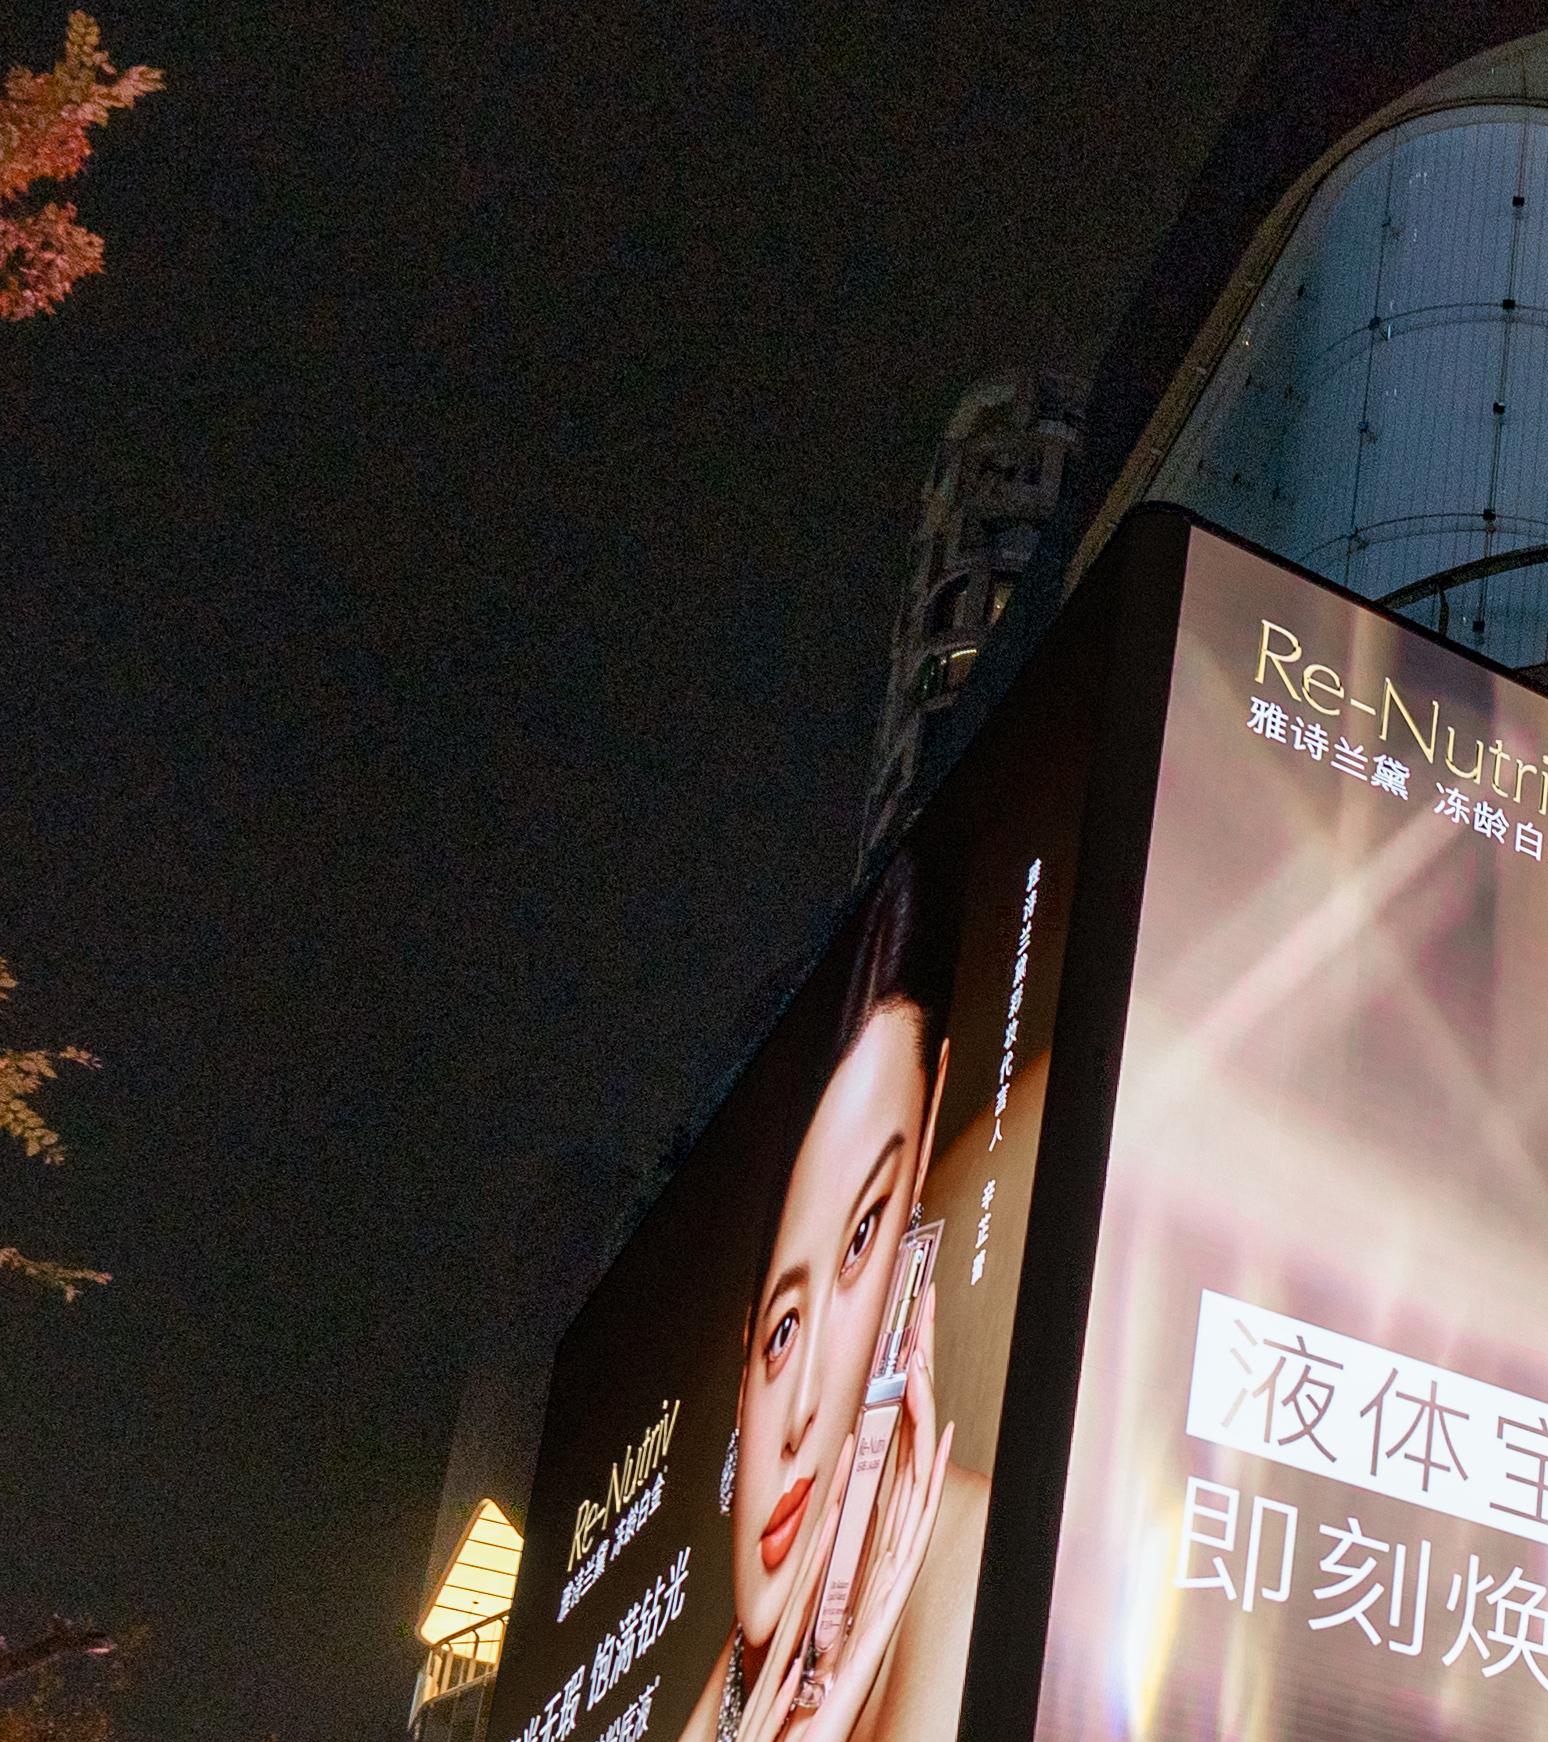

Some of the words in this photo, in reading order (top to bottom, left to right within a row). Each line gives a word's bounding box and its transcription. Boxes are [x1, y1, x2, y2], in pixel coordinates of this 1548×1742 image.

[1246, 696, 1411, 801] 雅诗兰黛
[567, 1399, 681, 1572] Re-Nutriv
[587, 1546, 692, 1712] 饱满钻光
